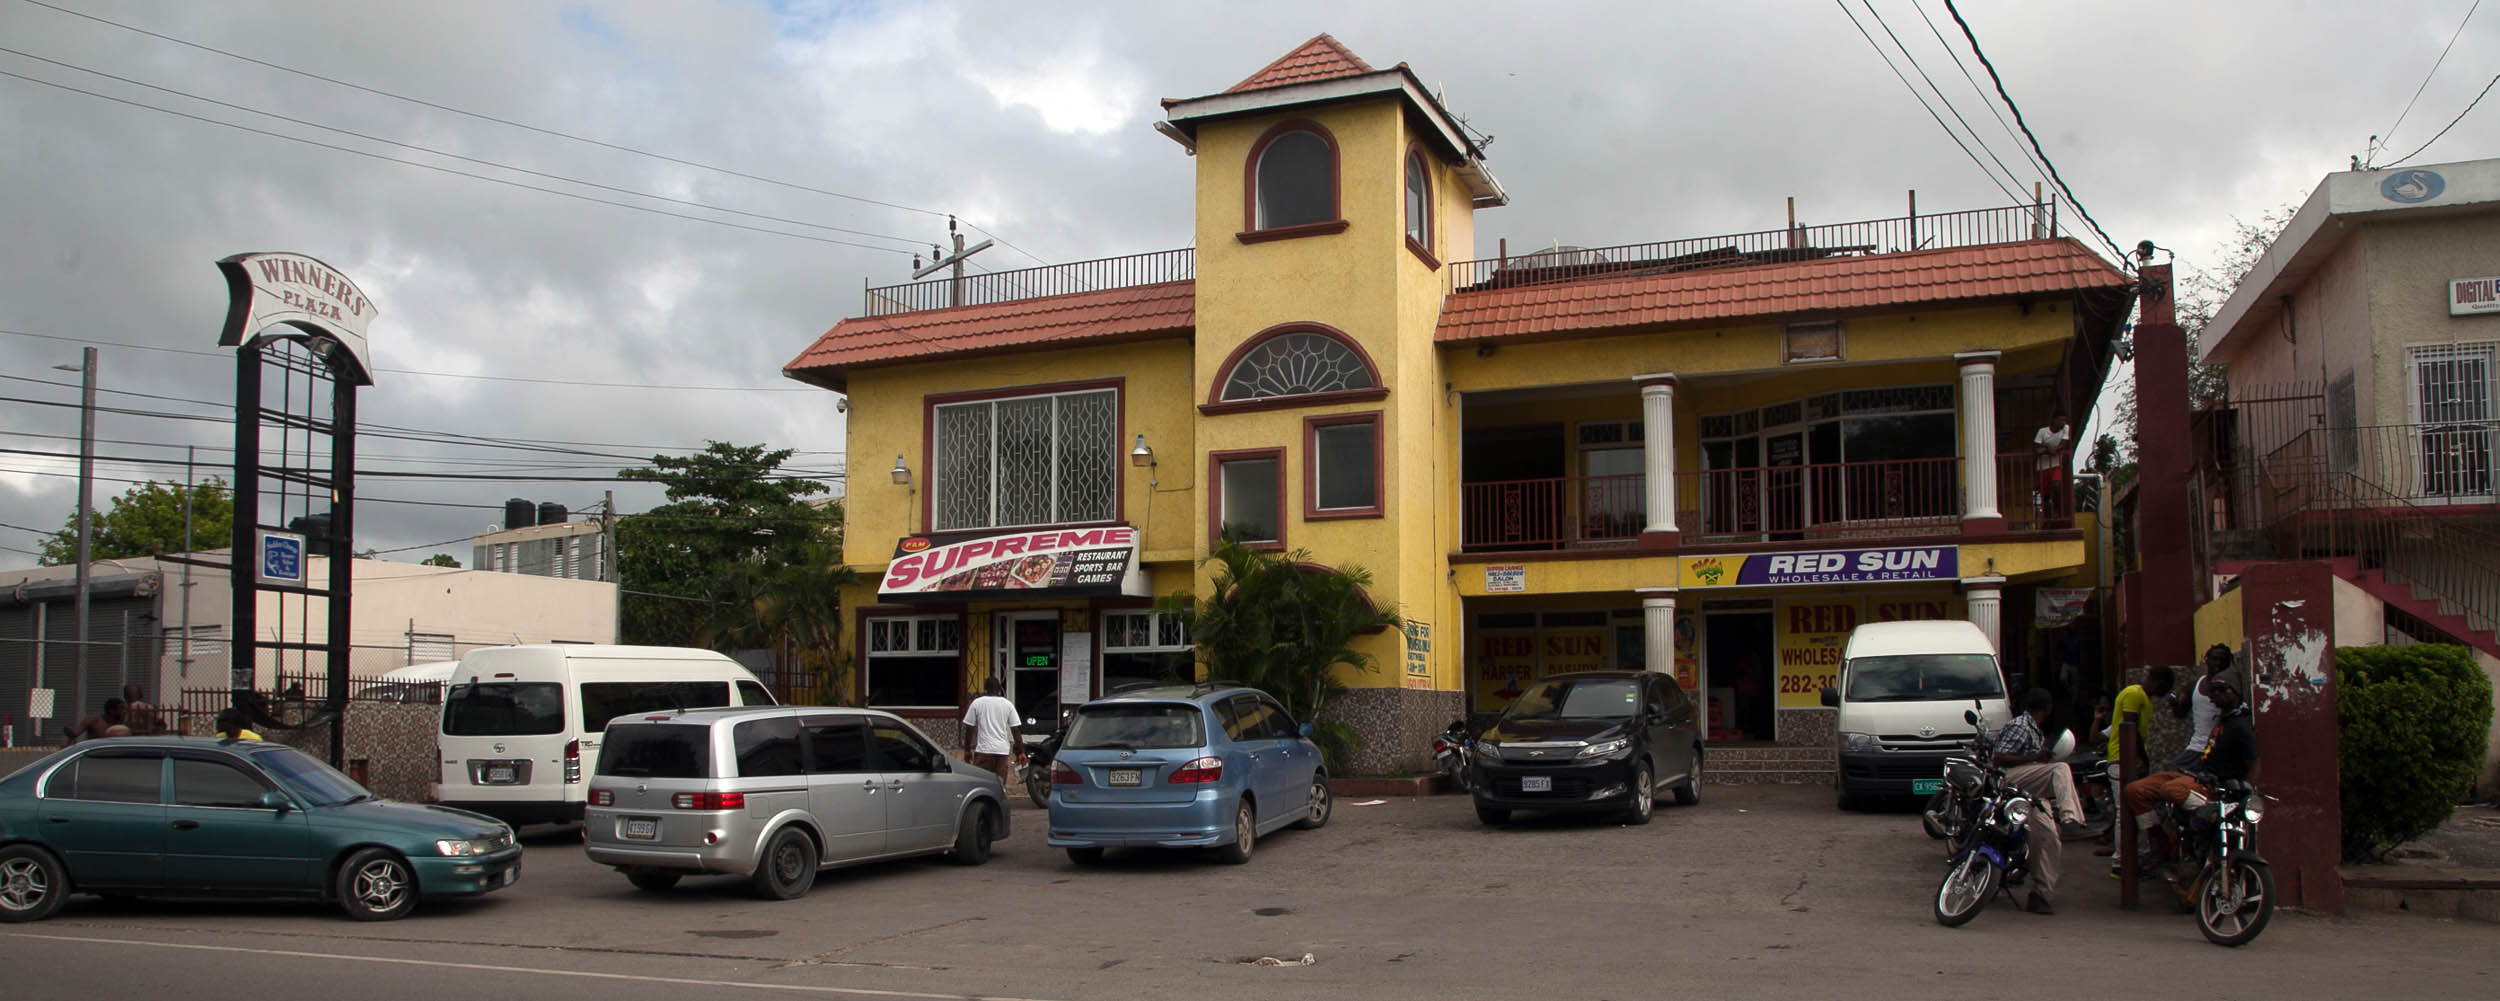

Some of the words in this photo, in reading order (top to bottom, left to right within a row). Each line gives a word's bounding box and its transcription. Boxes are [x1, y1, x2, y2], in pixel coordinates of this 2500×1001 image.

[257, 258, 366, 316] WINNERS
[2455, 280, 2496, 304] DIGITAL
[283, 290, 342, 321] PLAZA
[886, 528, 1133, 589] SUPREME
[1077, 550, 1128, 561] RESTAURANT
[1768, 553, 1846, 575] RED
[1857, 549, 1940, 572] SUN
[1074, 563, 1103, 573] SPORTS
[1106, 562, 1123, 571] BAR
[1077, 573, 1113, 584] GAMES
[1768, 572, 1860, 584] WHOLESALE
[1881, 570, 1936, 580] RETAIL
[1788, 604, 1856, 634] RED
[1547, 634, 1600, 656] SUN
[1026, 656, 1048, 666] OPEN
